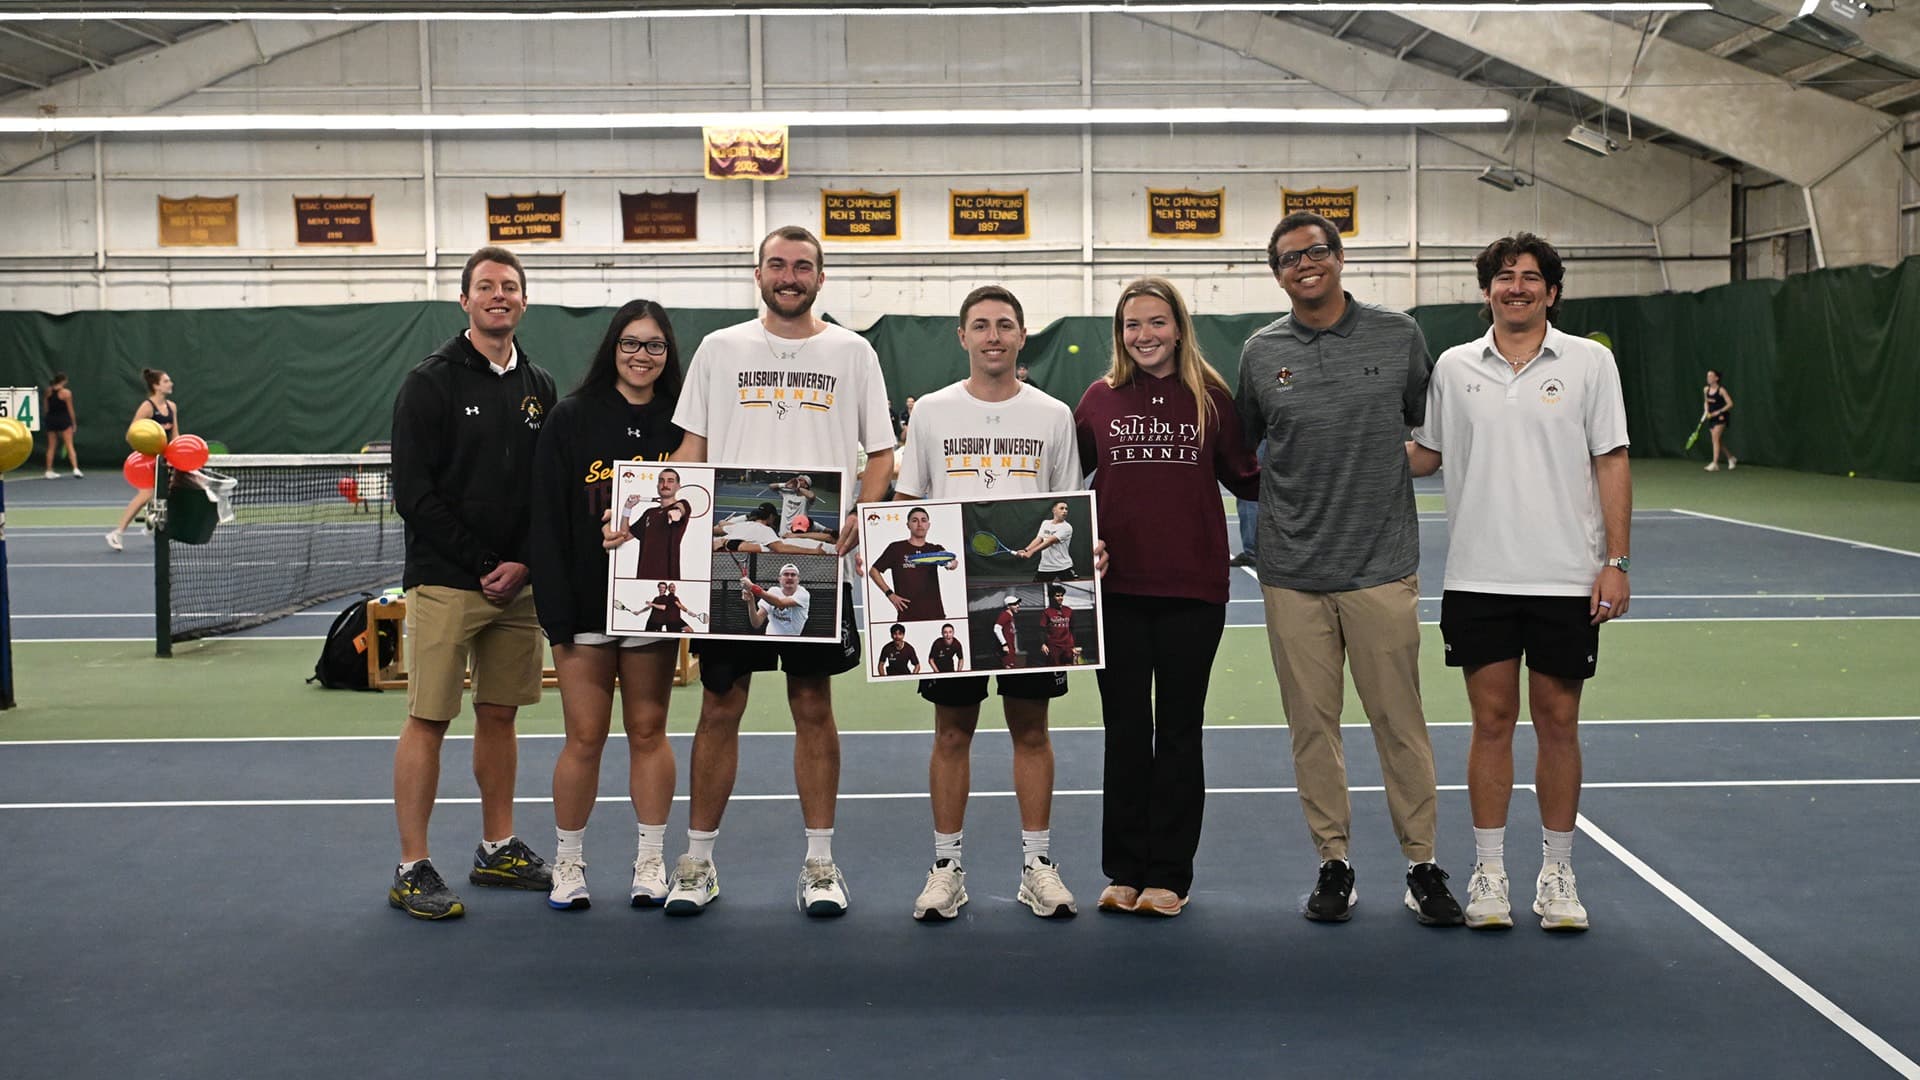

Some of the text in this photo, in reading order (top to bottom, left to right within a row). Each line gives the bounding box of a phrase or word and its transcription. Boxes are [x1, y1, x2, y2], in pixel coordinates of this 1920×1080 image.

[828, 198, 891, 208] CAC CHAMPIONS
[955, 198, 1023, 208] CAC CHAMPIONS
[1153, 197, 1219, 207] CAC CHAMPIONS
[1306, 197, 1352, 206] CHAMPIONS
[323, 203, 367, 211] CHAMPIONS
[861, 211, 891, 220] TENNIS
[988, 210, 1018, 220] TENNIS
[1185, 209, 1217, 218] TENNIS
[1321, 208, 1350, 218] TENNIS
[334, 216, 361, 225] TENNIS
[489, 213, 561, 224] ESAC CHAMPIONS
[526, 225, 552, 233] TENNIS
[850, 223, 871, 233] 1996
[978, 222, 999, 232] 1997
[1175, 221, 1197, 230] 1998
[738, 371, 837, 393] SALISBURY UNIVERSITY
[739, 389, 834, 405] TENNIS
[17, 395, 34, 428] 4
[1109, 417, 1200, 440] Salisbury
[1119, 434, 1190, 442] UNIVERSIY
[944, 438, 1044, 456] SALISBURY UNIVERSITY
[1110, 448, 1198, 461] TENNIS
[945, 456, 1040, 470] TENNIS
